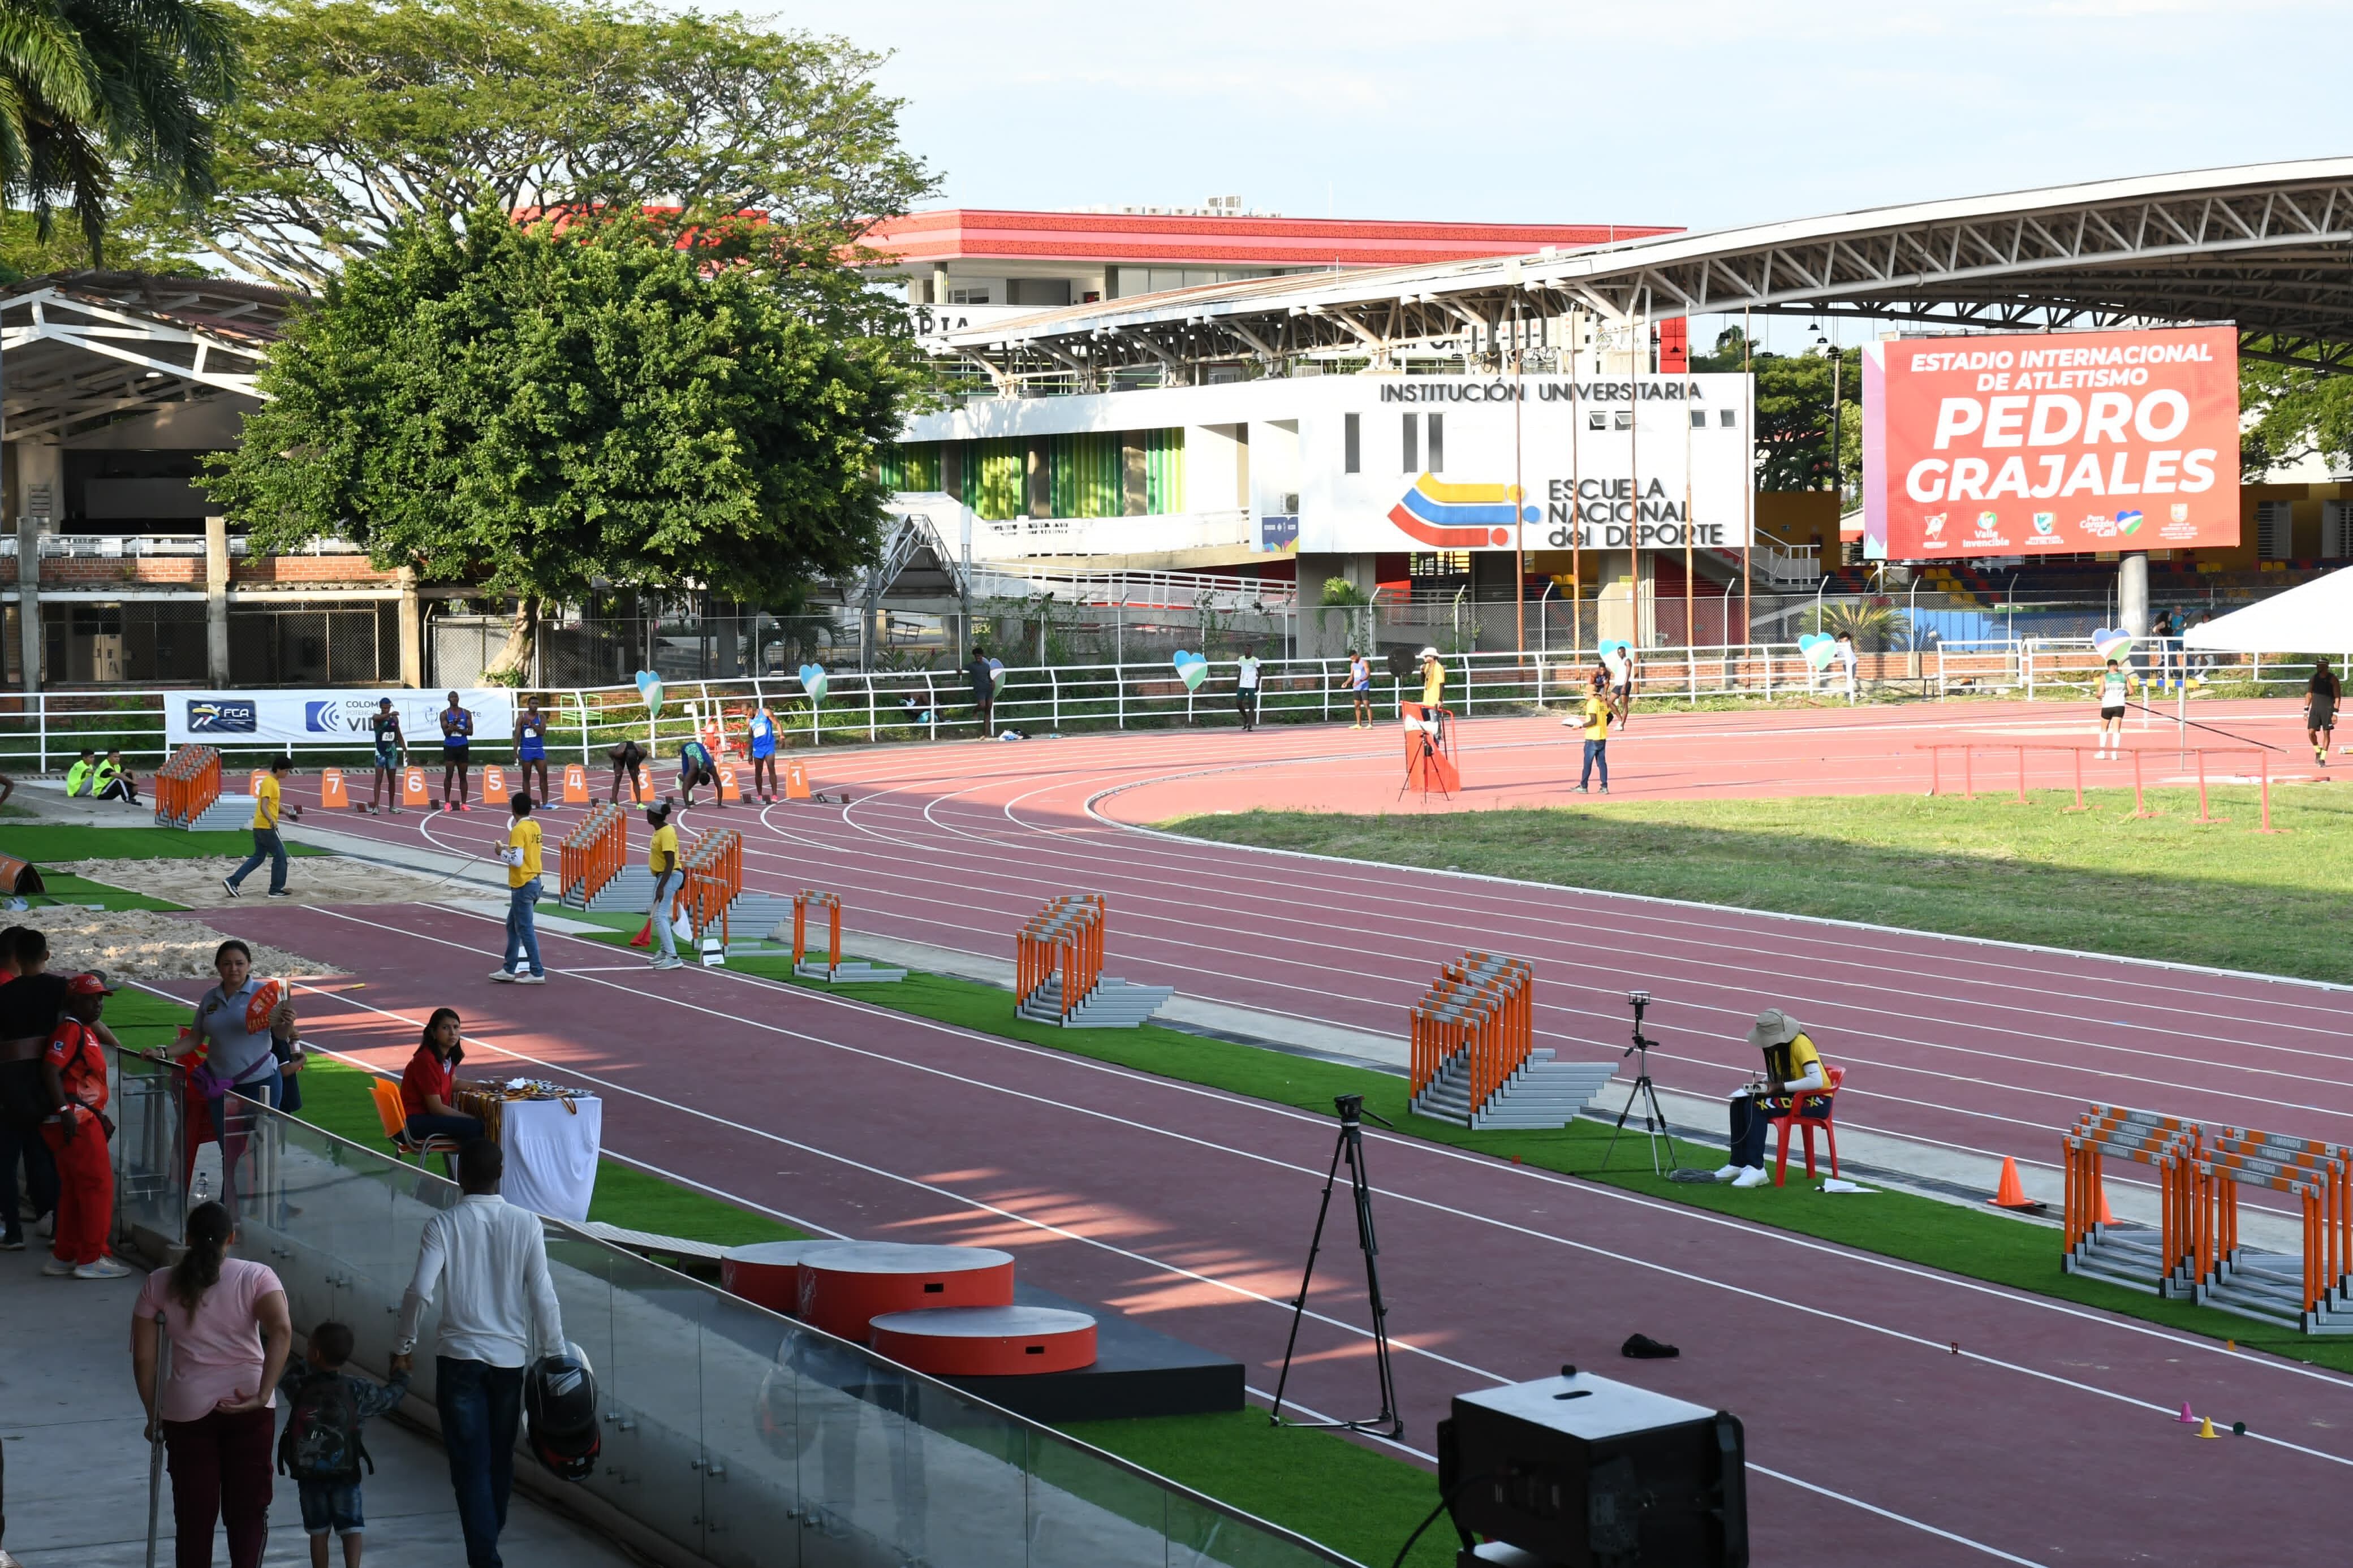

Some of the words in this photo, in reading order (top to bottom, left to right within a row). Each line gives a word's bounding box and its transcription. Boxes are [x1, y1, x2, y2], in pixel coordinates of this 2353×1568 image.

[1911, 351, 2014, 372] ESTADIO
[2019, 344, 2213, 369] INTERNACIONAL
[1976, 373, 2010, 392] DE
[2014, 368, 2149, 391] ATLETISMO
[1380, 377, 1525, 402] INSTITUCIÓN
[1538, 382, 1703, 401] UNIVERSITARIA
[1933, 388, 2190, 450] PEDRO
[1906, 448, 2218, 503] GRAJALES
[1548, 478, 1666, 500] ESCUELA
[1548, 501, 1693, 524] NACIONAL
[1548, 525, 1591, 547] del
[1606, 524, 1723, 547] DEPORTE
[1974, 528, 1998, 539] Valle
[2097, 526, 2118, 537] Cali
[1963, 537, 2010, 548] Invencible
[224, 709, 249, 718] FCA
[326, 777, 340, 794] 7
[408, 775, 423, 792] 6
[488, 774, 502, 791] 5
[568, 774, 583, 791] 4
[637, 771, 649, 789] 3
[720, 770, 734, 787] 2
[791, 770, 801, 787] 1
[2276, 1136, 2302, 1148] MONDO
[2266, 1148, 2290, 1161] MONDO
[2252, 1161, 2276, 1173] MONDO
[2242, 1172, 2265, 1185] MONDO
